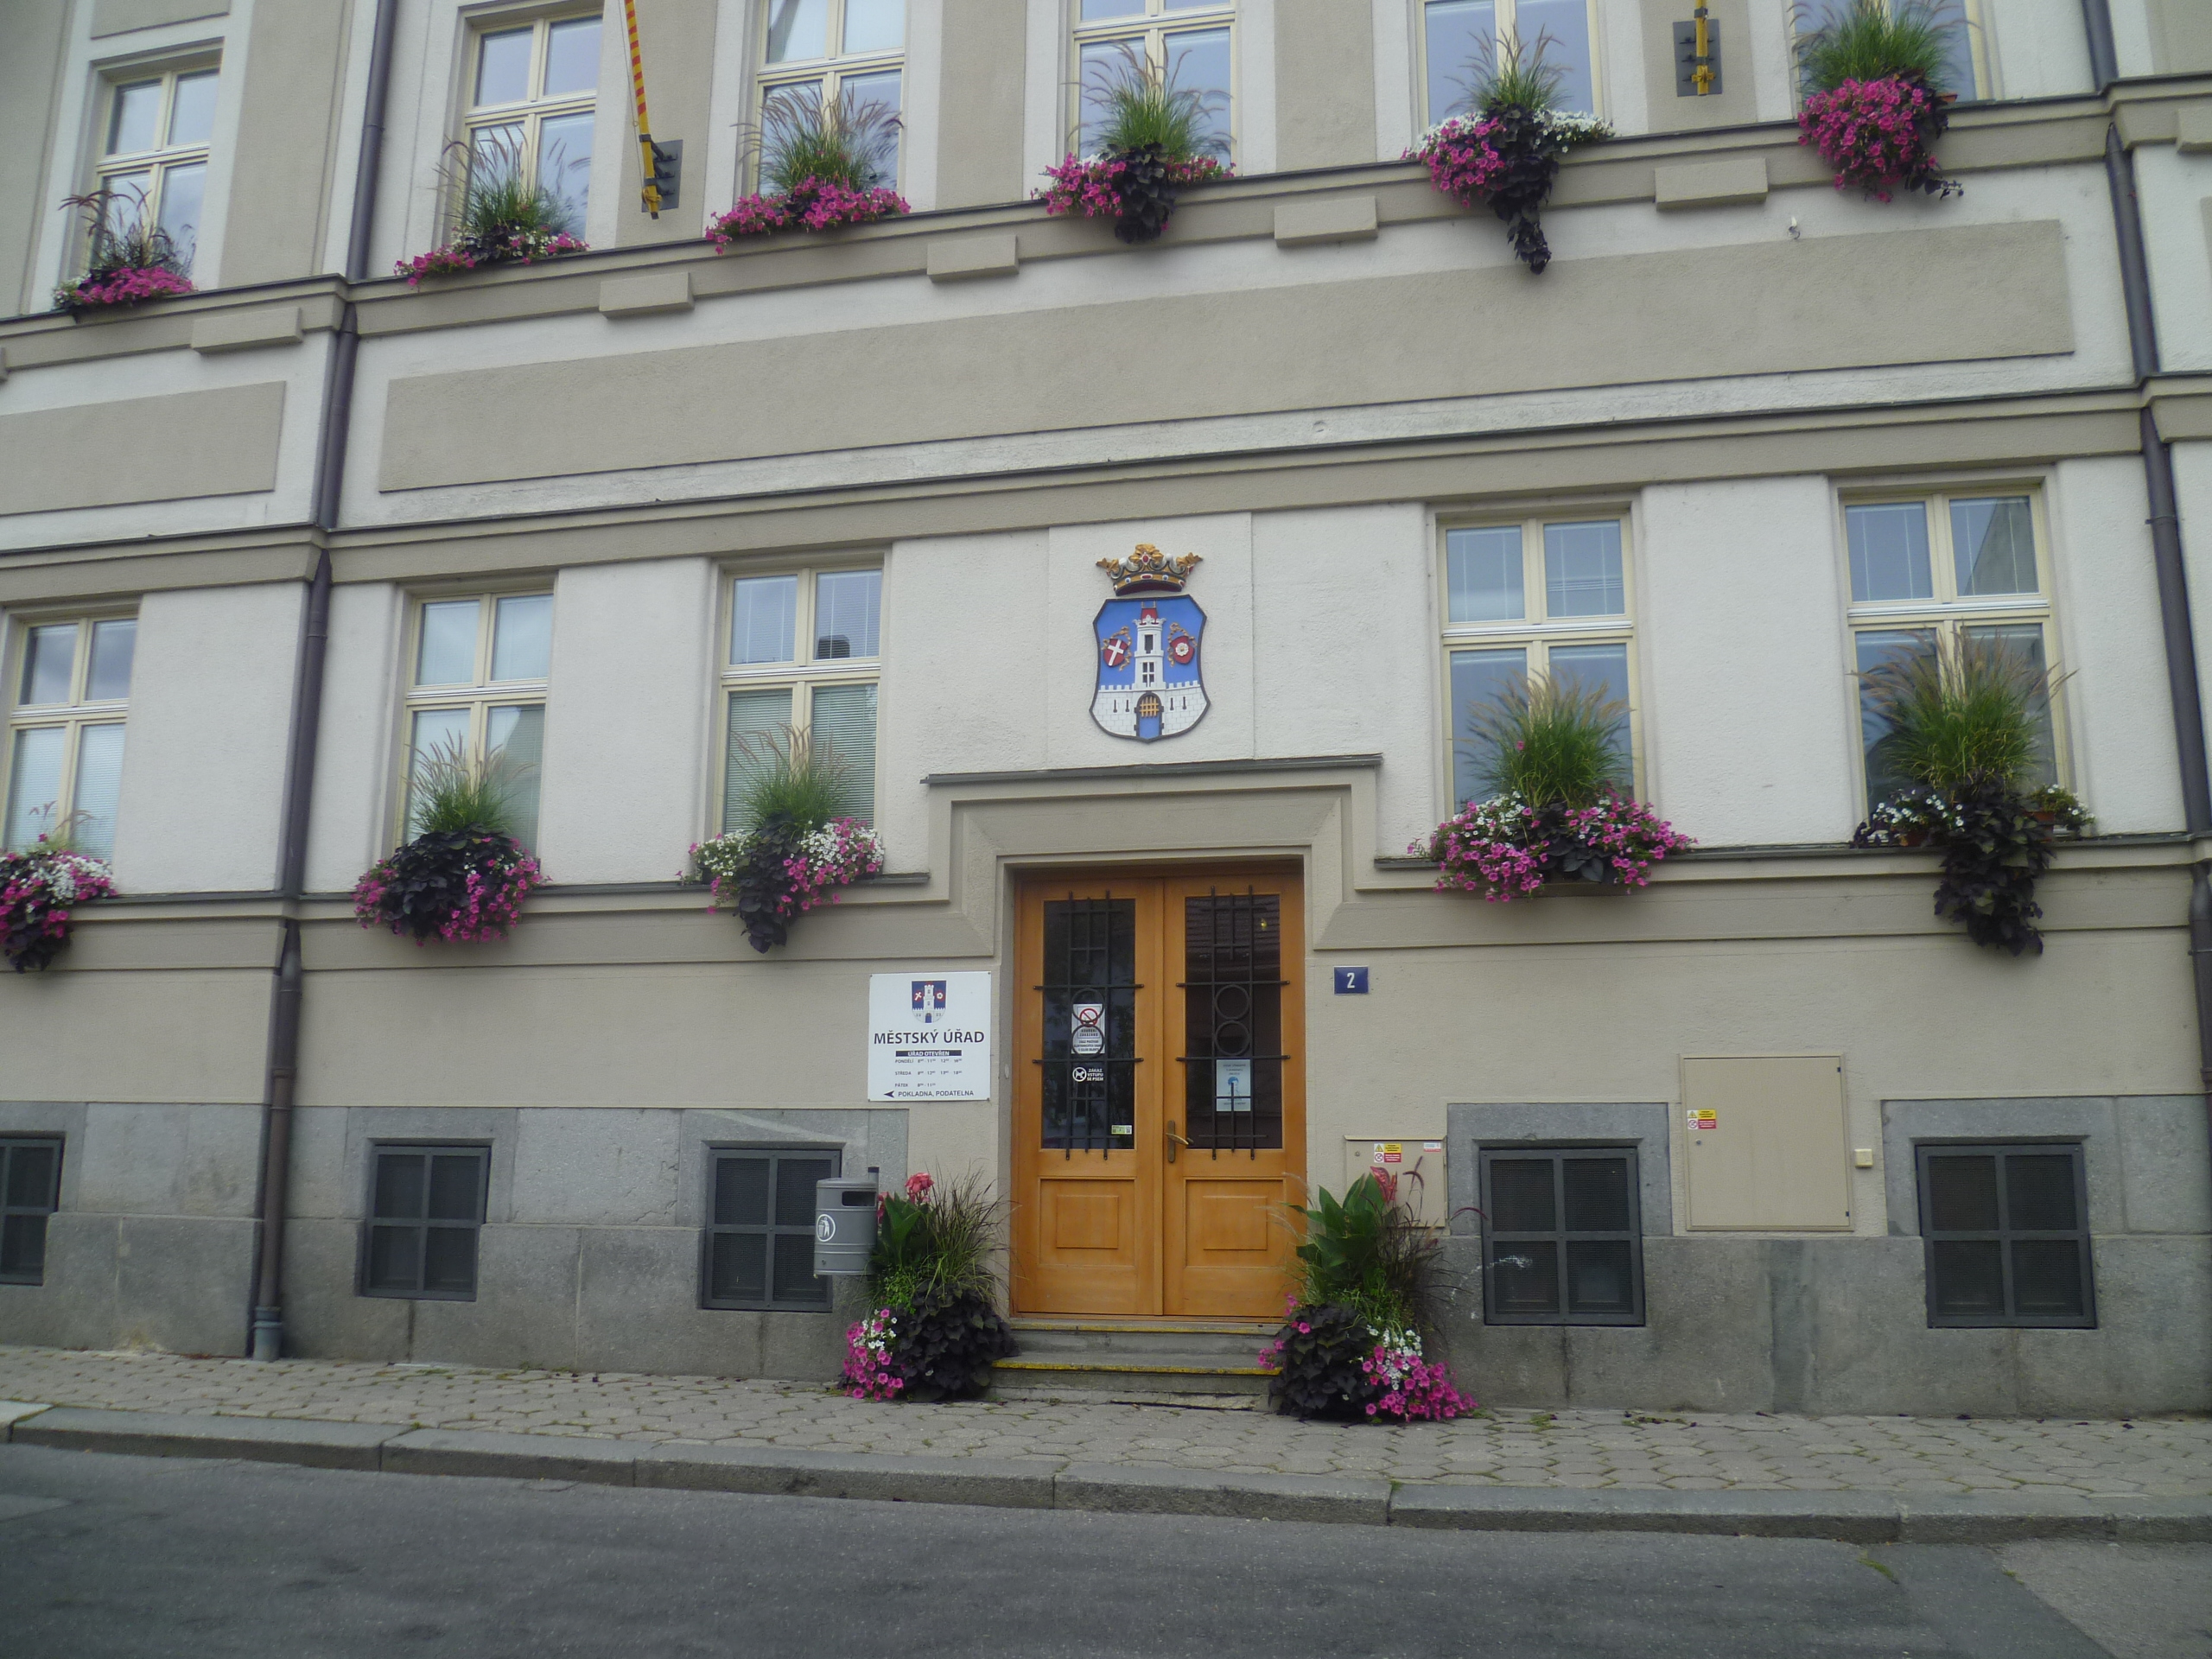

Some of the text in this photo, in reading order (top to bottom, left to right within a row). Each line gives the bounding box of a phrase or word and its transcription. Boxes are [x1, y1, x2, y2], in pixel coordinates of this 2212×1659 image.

[1346, 972, 1356, 989] 2
[874, 1028, 985, 1045] MĚSTSKÝ ÚŘAD
